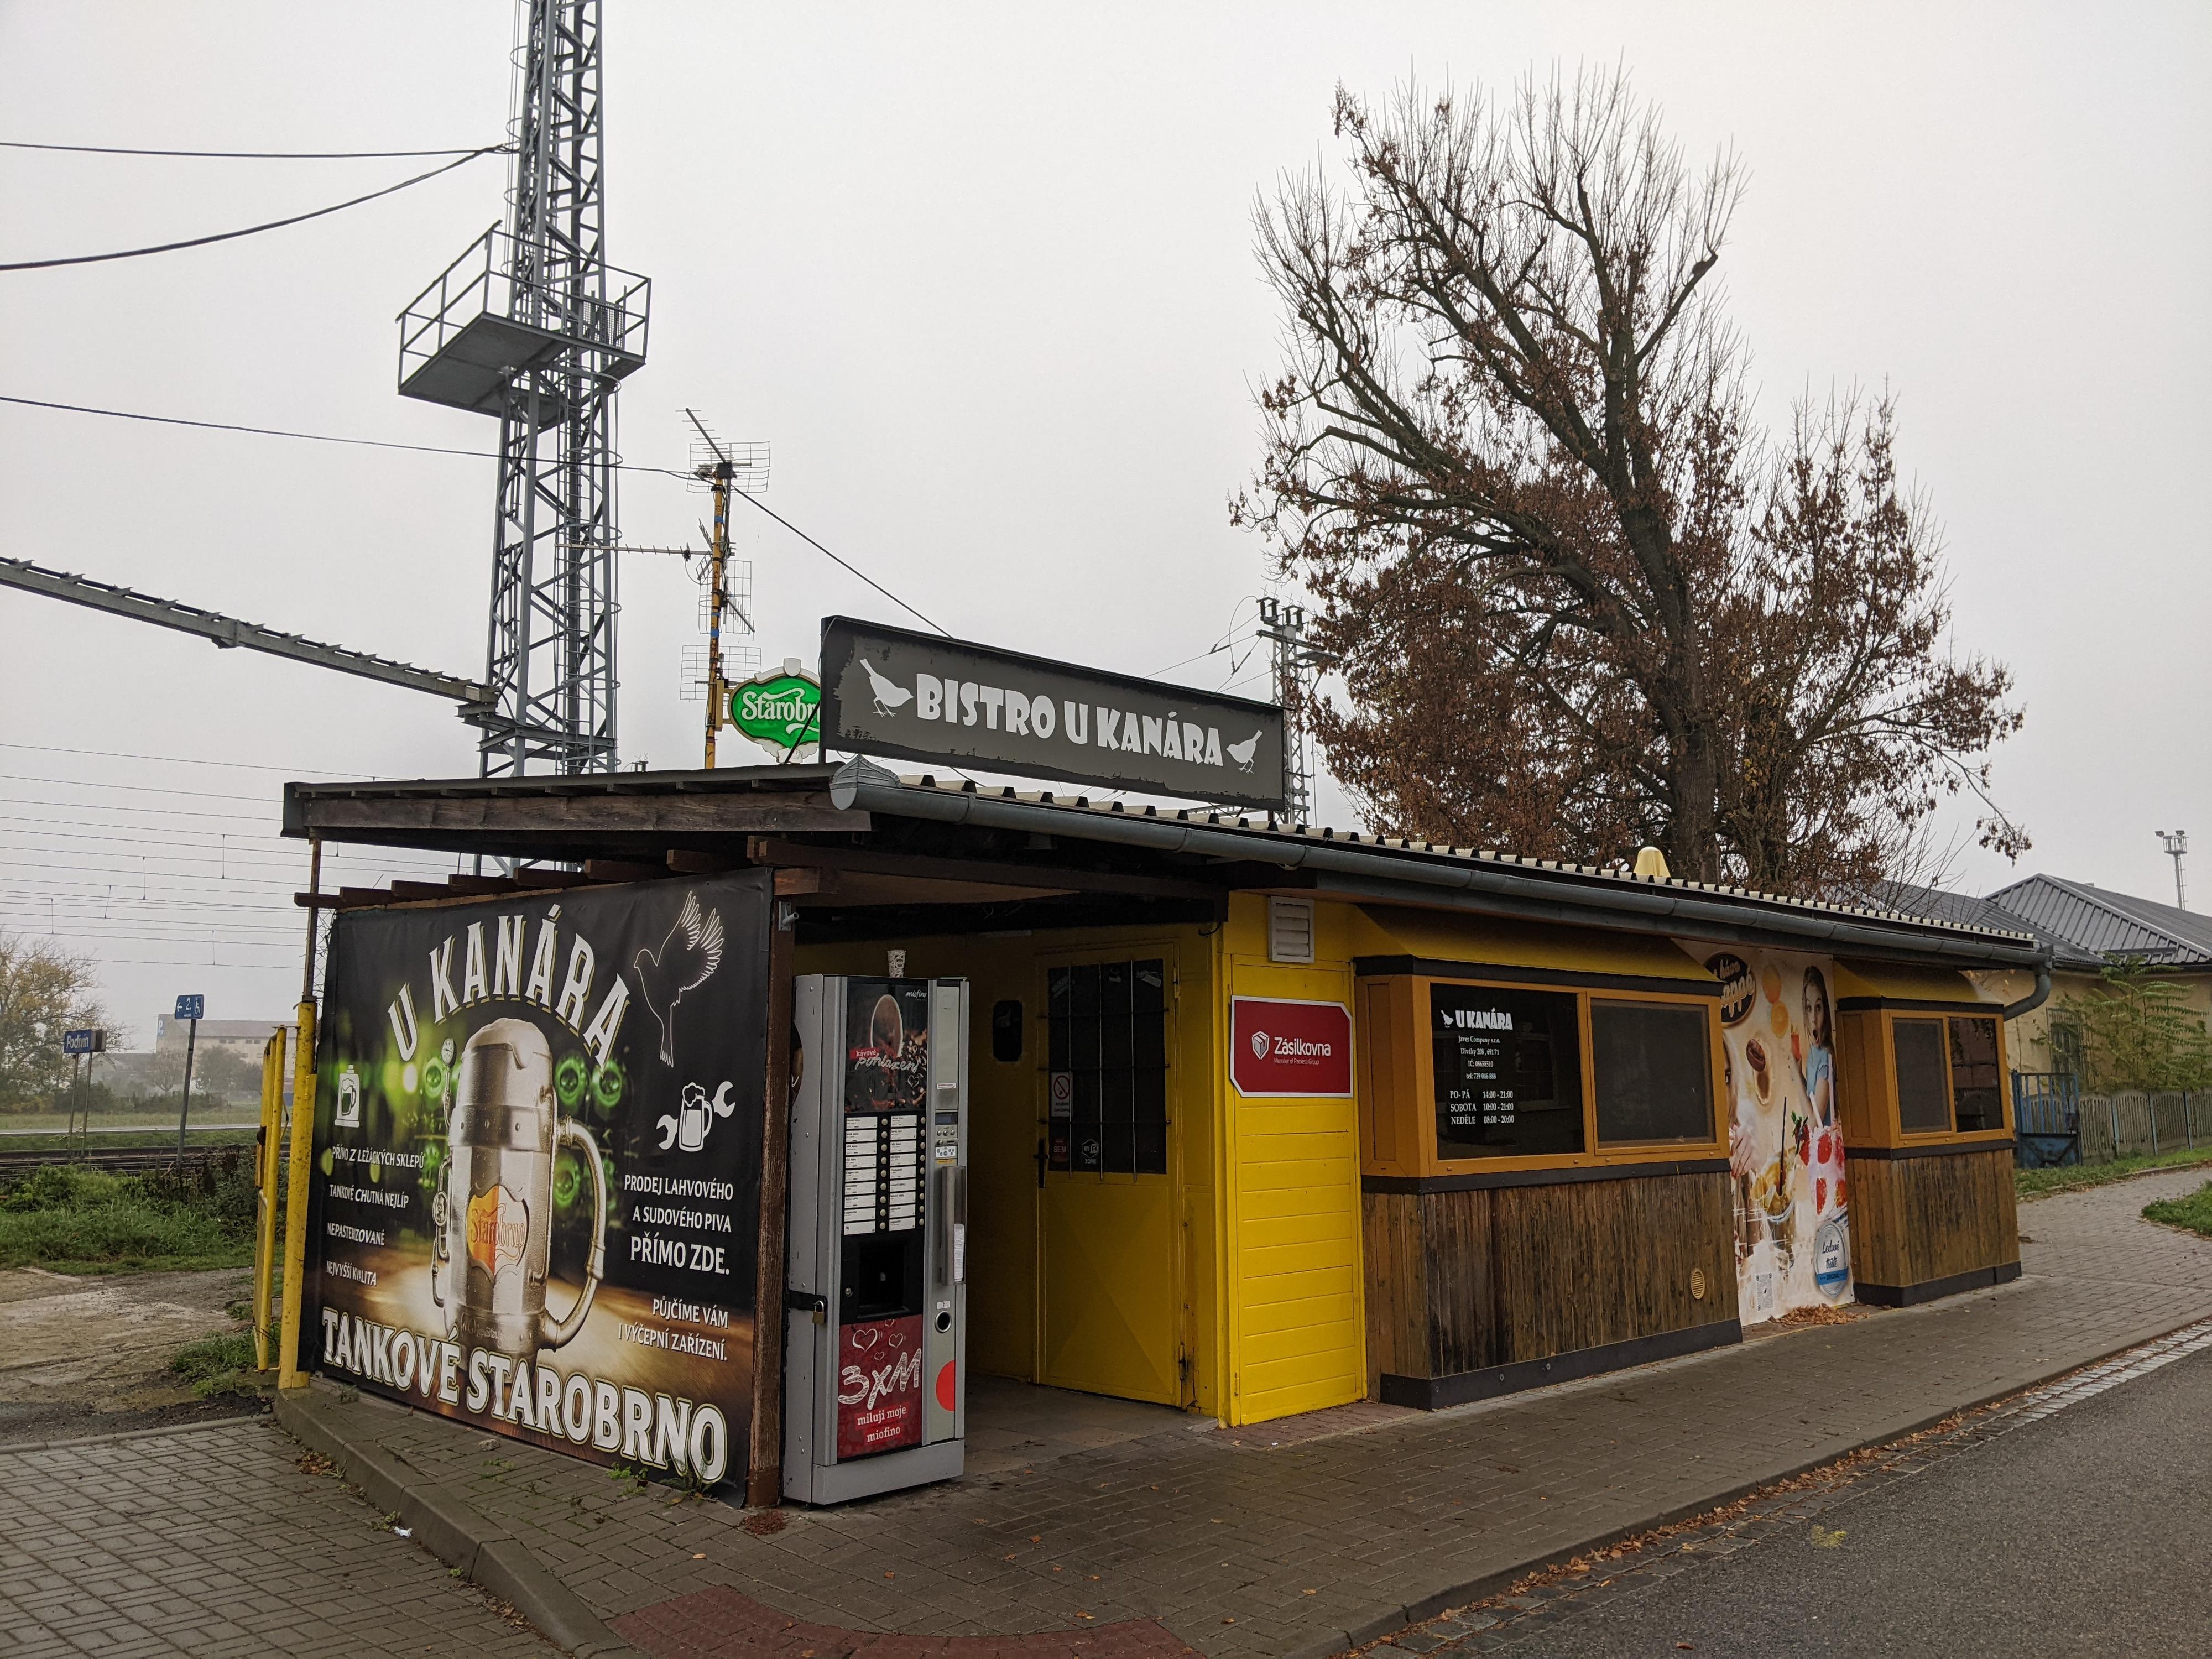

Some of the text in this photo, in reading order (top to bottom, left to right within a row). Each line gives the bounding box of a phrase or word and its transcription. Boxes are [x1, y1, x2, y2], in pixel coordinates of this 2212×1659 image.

[741, 687, 820, 722] Starobr
[916, 673, 1224, 766] BISTRO U KANÁRA
[388, 903, 630, 1079] U KANÁRA
[1455, 1007, 1514, 1030] U KANÁRA
[66, 1033, 89, 1050] Podivín
[1274, 1037, 1331, 1057] Zásilkovna
[1458, 1035, 1469, 1044] Javer
[1470, 1035, 1490, 1045] Company
[854, 1052, 920, 1074] pohlazení
[855, 1048, 877, 1057] kávové
[1462, 1088, 1470, 1099] PÁ
[1482, 1090, 1496, 1099] 14:00
[1500, 1090, 1514, 1099] 21:00
[1450, 1103, 1477, 1112] SOBOTA
[1483, 1103, 1496, 1111] 10:00
[1500, 1103, 1514, 1111] 21:00
[1451, 1114, 1476, 1125] NEDĚLE
[1483, 1115, 1497, 1124] 08:00
[1501, 1115, 1515, 1124] 20:00
[349, 1149, 357, 1161] Z
[357, 1147, 395, 1166] LEŽÁCKÝCH
[395, 1152, 425, 1169] SKLEPŮ
[330, 1184, 409, 1209] TANKOVÉ CHUTNÁ NEJLÍP
[624, 1174, 734, 1201] PRODEJ LAHVOVÉHO
[632, 1205, 732, 1233] A SUDOVÉHO PIVA
[327, 1222, 385, 1245] NEPASTERIZOVANÉ
[630, 1231, 730, 1275] PŘÍMO ZDE.
[326, 1260, 377, 1286] NEJVYŠŠÍ KVALITA
[653, 1295, 729, 1329] PŮJČÍME VÁM
[619, 1321, 728, 1361] I VÝČEPNÍ ZAŘÍZENÍ.
[322, 1307, 727, 1484] TANKOVÉ STAROBRNO
[857, 1405, 906, 1426] miluji moje
[867, 1426, 901, 1443] miofino
